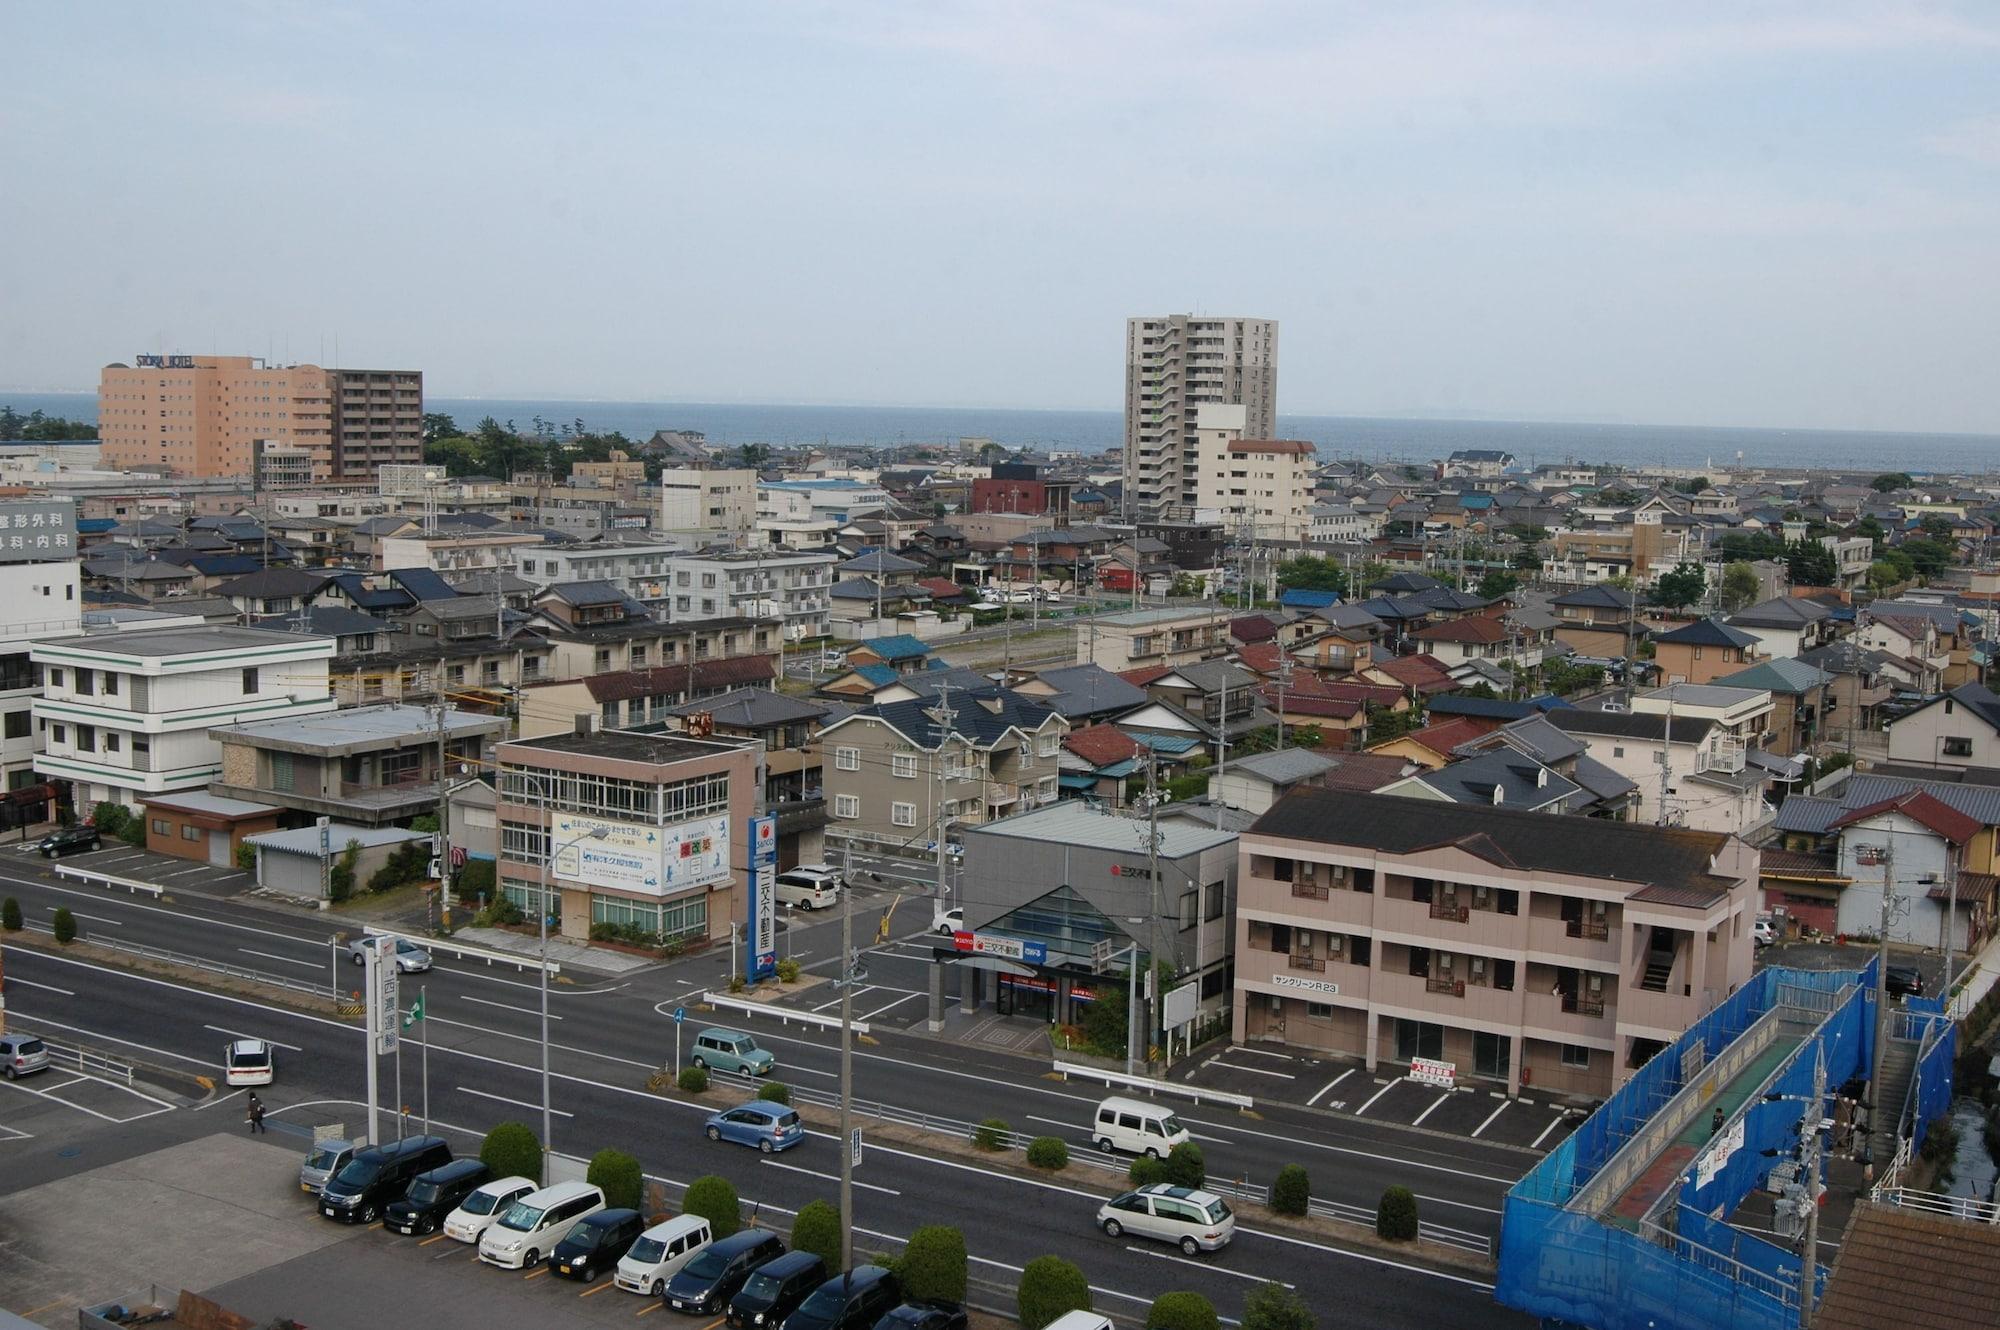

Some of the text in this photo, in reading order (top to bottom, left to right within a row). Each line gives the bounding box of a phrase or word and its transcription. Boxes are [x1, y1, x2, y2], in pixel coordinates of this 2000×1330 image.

[760, 870, 770, 949] 三交不動産
[756, 956, 764, 970] P
